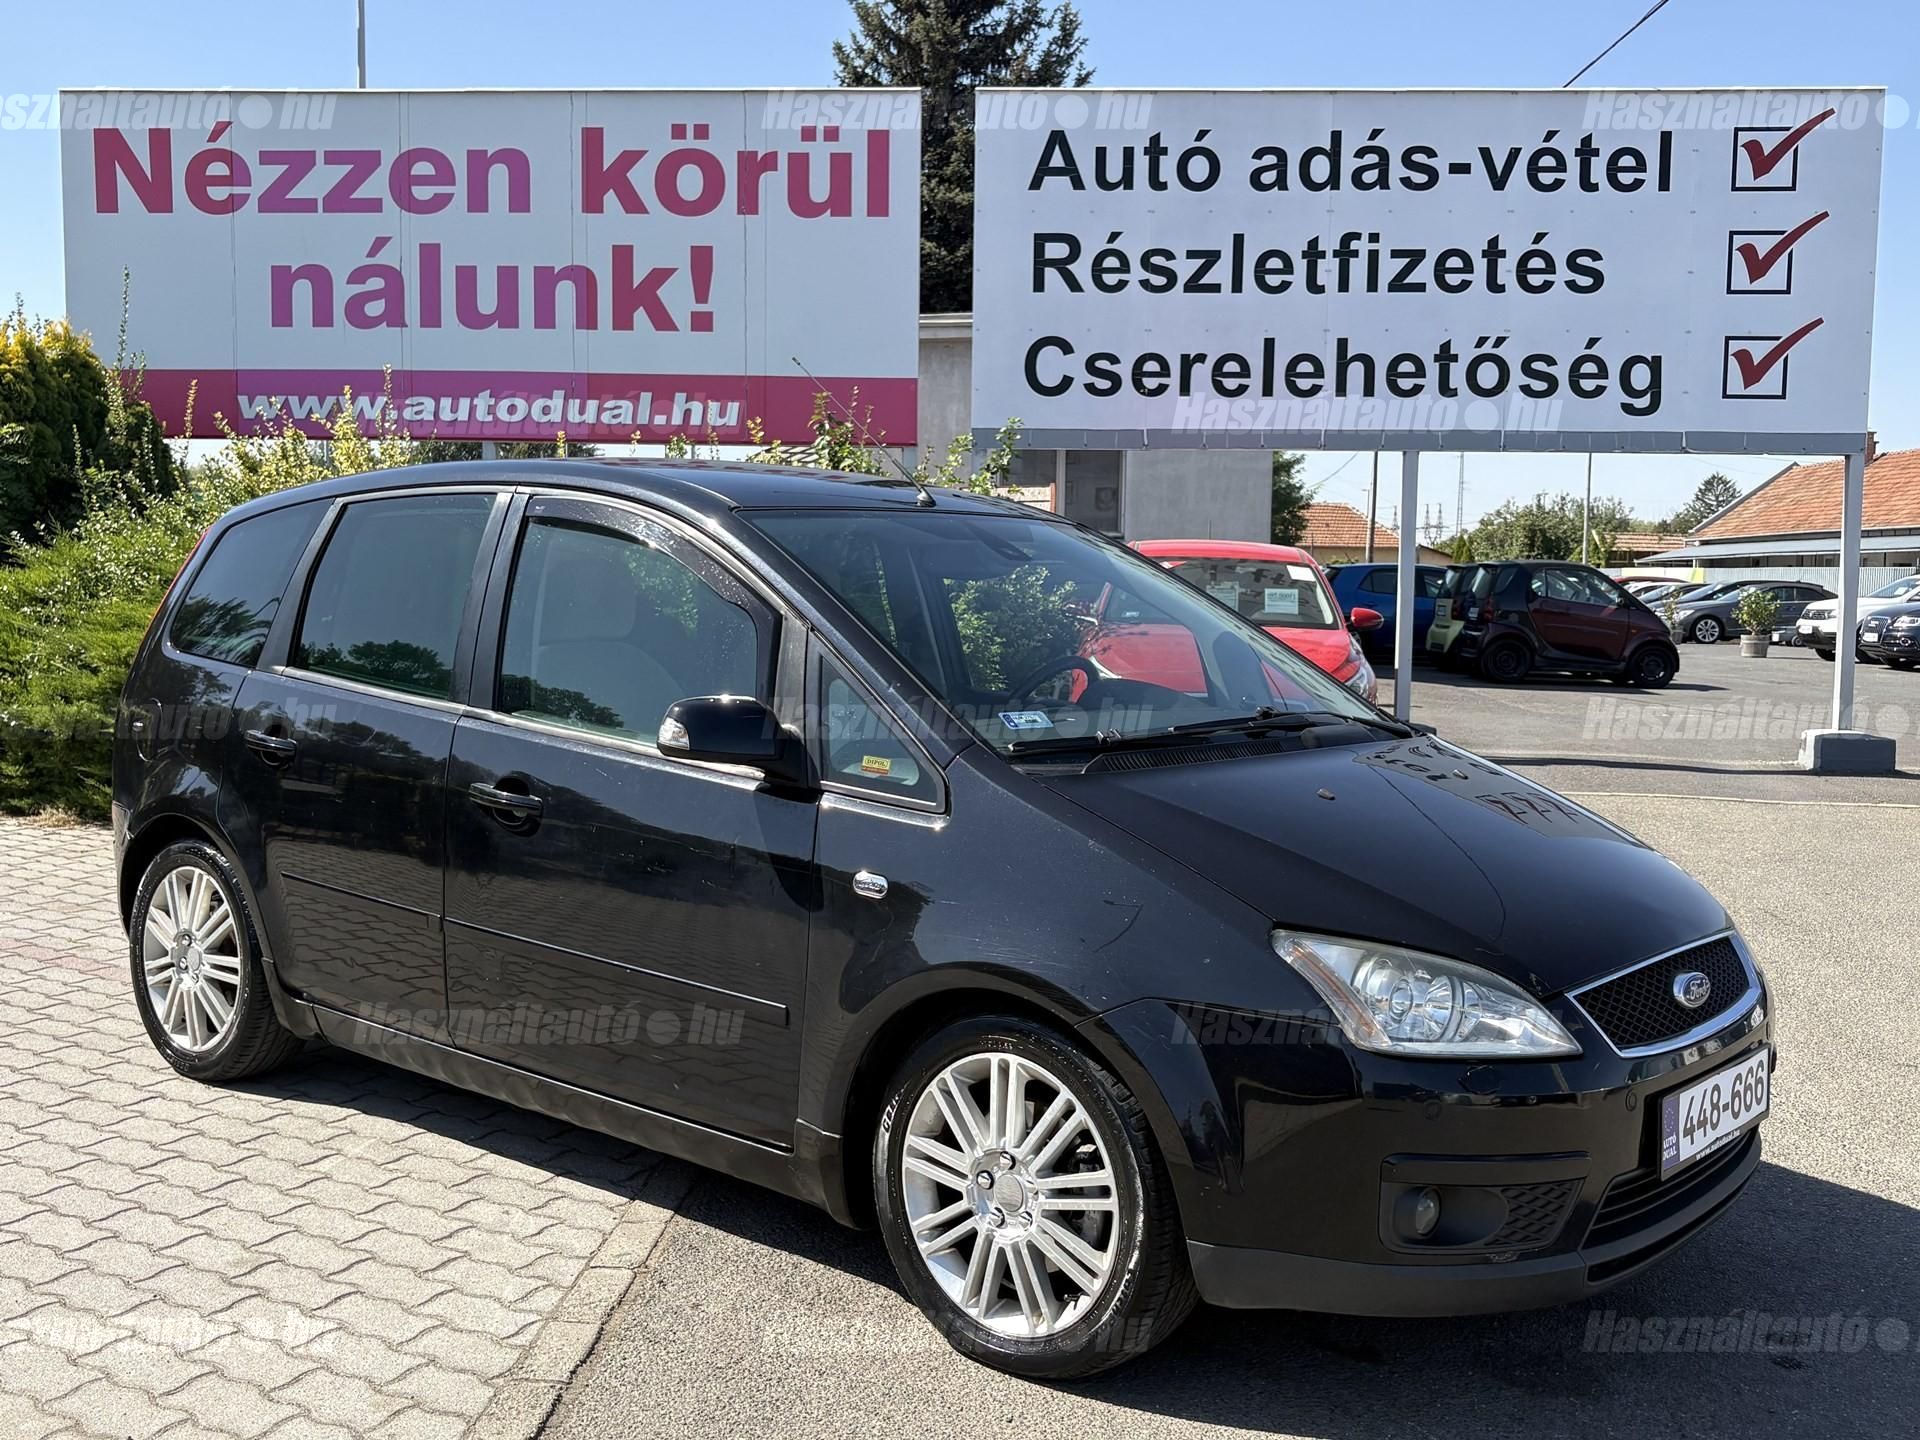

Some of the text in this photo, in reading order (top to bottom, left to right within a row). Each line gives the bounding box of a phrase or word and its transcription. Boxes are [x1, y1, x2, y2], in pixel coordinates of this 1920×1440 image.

[93, 121, 890, 218] Nézzen körül
[1027, 128, 1673, 192] Autó adás-vétel
[270, 236, 714, 333] nálunk!
[1032, 231, 1605, 295] Részletfizetés
[238, 390, 740, 427] www.autodual.hu
[1024, 336, 1663, 417] Cserelehetőség
[1683, 1059, 1765, 1146] 448-666
